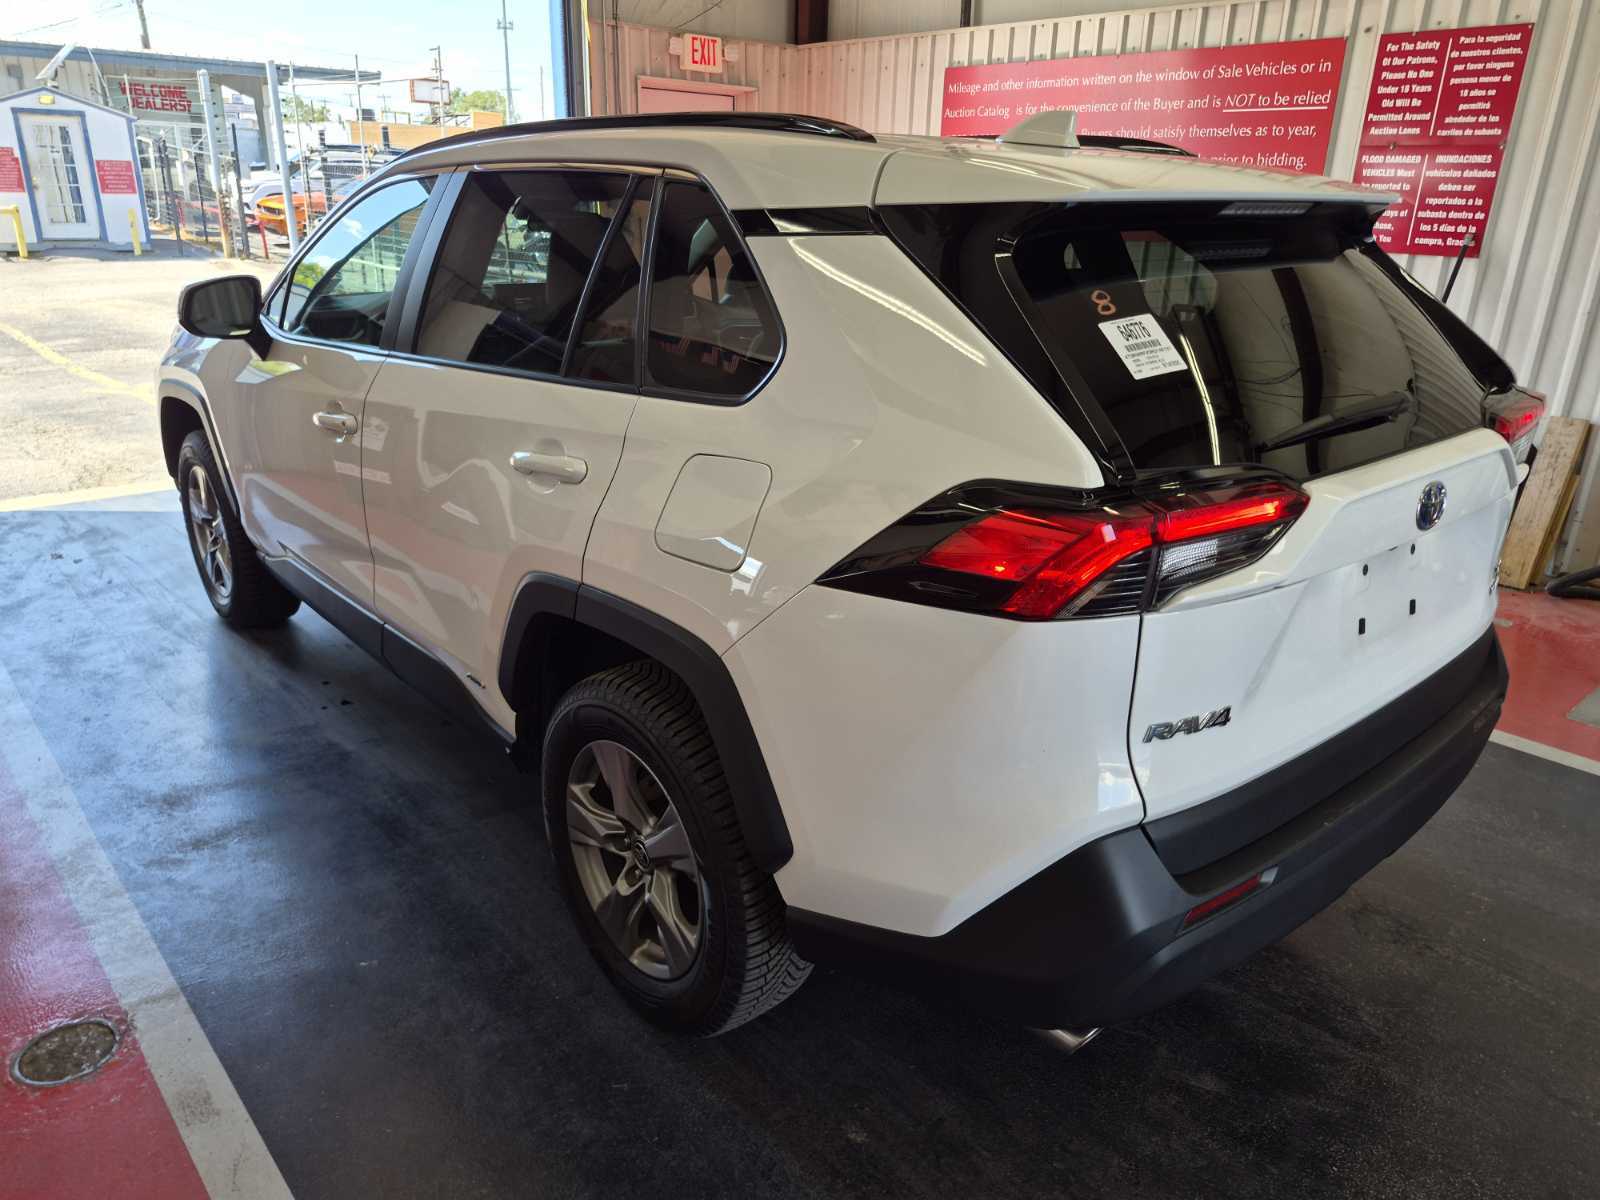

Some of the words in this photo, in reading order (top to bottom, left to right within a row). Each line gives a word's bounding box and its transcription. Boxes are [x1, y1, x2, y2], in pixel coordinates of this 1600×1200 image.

[1459, 35, 1476, 45] Para
[1478, 35, 1485, 43] la
[1485, 33, 1522, 45] seguridad
[691, 36, 717, 66] EXIT
[1386, 43, 1400, 52] For
[1401, 42, 1415, 51] The
[1415, 40, 1441, 51] Safety
[1451, 50, 1460, 58] de
[1461, 48, 1491, 58] nuestros
[1382, 57, 1391, 66] Of
[1392, 57, 1405, 66] Our
[1406, 55, 1438, 65] Patrons,
[1453, 63, 1465, 72] por
[1466, 62, 1484, 71] favor
[948, 82, 980, 95] Mileage
[982, 80, 999, 91] and
[1001, 78, 1024, 90] other
[1027, 74, 1079, 90] information
[1082, 73, 1116, 86] written
[1119, 74, 1132, 84] on
[1136, 70, 1152, 83] the
[1156, 67, 1200, 81] window
[1203, 65, 1216, 79] of
[1218, 63, 1243, 79] Sale
[1245, 60, 1297, 77] Vehicles
[1300, 63, 1316, 74] or
[1319, 59, 1332, 73] in
[1381, 71, 1405, 81] Please
[1407, 71, 1418, 79] No
[1419, 70, 1434, 79] One
[1450, 77, 1477, 86] persona
[1479, 75, 1501, 83] menor
[1502, 74, 1512, 82] de
[119, 80, 187, 99] WELCOME
[1377, 85, 1399, 94] Under
[1400, 85, 1410, 94] 18
[1411, 84, 1432, 93] Years
[944, 106, 975, 119] Auction
[976, 104, 1010, 120] Catalog
[1016, 104, 1023, 116] is
[1025, 104, 1037, 115] for
[1040, 102, 1055, 113] the
[1056, 100, 1118, 113] convenience
[1120, 98, 1133, 112] of
[1134, 98, 1151, 111] the
[1153, 97, 1185, 114] Buyer
[1187, 95, 1208, 108] and
[1213, 95, 1221, 108] is
[1224, 94, 1257, 108] NOT
[1259, 95, 1271, 106] to
[1274, 92, 1289, 106] be
[1293, 90, 1332, 105] relied
[1381, 99, 1395, 108] Old
[1396, 98, 1411, 107] Will
[1411, 99, 1422, 107] Be
[1367, 113, 1403, 122] Permitted
[1404, 112, 1431, 121] Around
[1478, 114, 1487, 123] de
[1488, 114, 1500, 122] los
[1116, 125, 1151, 139] should
[1153, 126, 1185, 141] satisfy
[1189, 124, 1252, 139] themselves
[1255, 127, 1268, 137] as
[1272, 125, 1284, 136] to
[1288, 126, 1317, 141] year,
[1369, 126, 1397, 135] Auction
[1399, 126, 1421, 135] Lanes
[1464, 127, 1473, 136] de
[1474, 127, 1502, 136] subasta
[1241, 153, 1254, 164] to
[1256, 152, 1308, 171] bidding.
[1361, 155, 1384, 164] FLOOD
[1385, 155, 1422, 164] DAMAGED
[1435, 154, 1493, 164] INUNDACIONES
[1362, 168, 1396, 177] VEHICLES
[1397, 169, 1416, 177] Must
[1371, 182, 1402, 191] reported
[1403, 183, 1411, 191] to
[1438, 183, 1462, 192] deben
[1463, 184, 1476, 192] ser
[1474, 197, 1484, 206] la
[1400, 209, 1408, 217] of
[1417, 211, 1447, 219] subasta
[1448, 210, 1473, 220] dentro
[1474, 211, 1485, 220] de
[1420, 223, 1431, 231] los
[1432, 223, 1438, 231] 5
[1457, 224, 1467, 233] de
[1468, 224, 1477, 233] la
[1379, 234, 1392, 243] You
[1091, 289, 1116, 315] 8
[1142, 705, 1232, 743] RAV4
